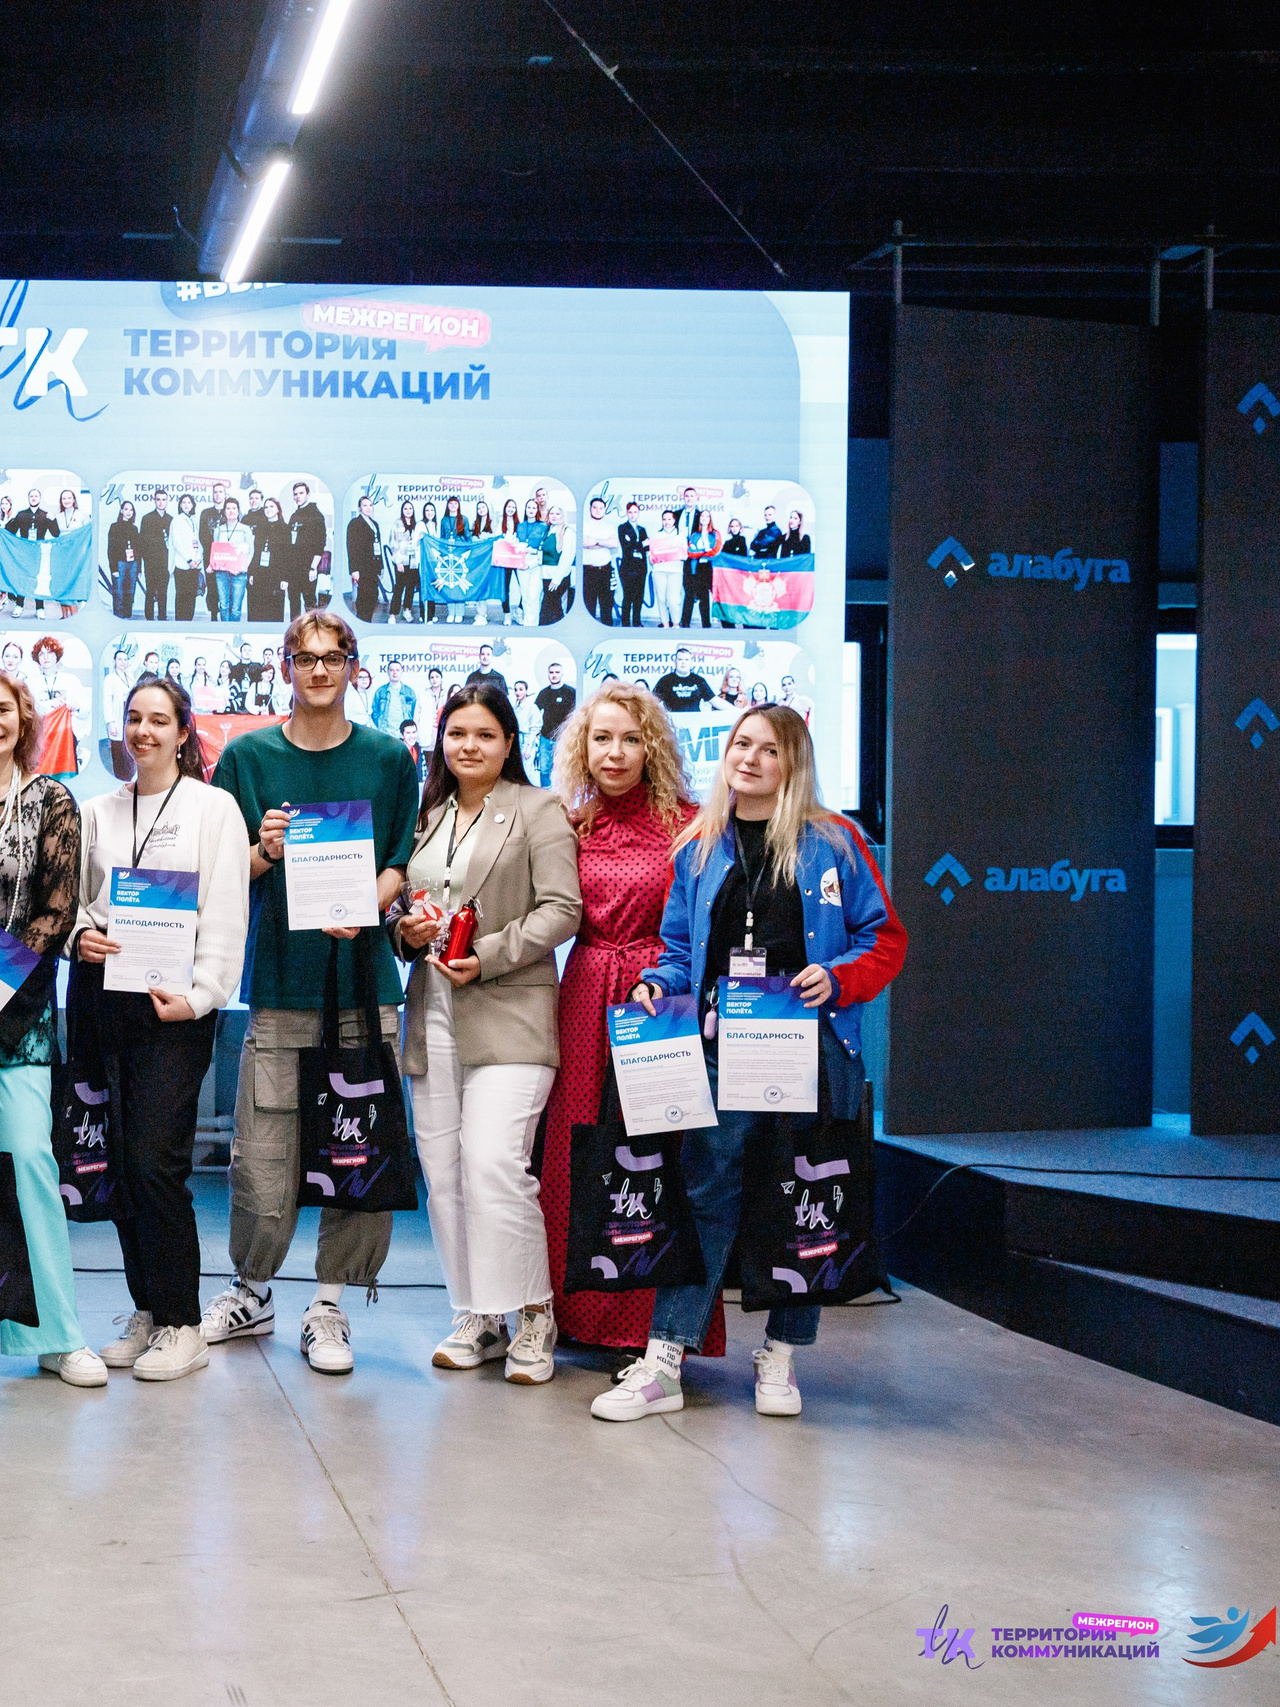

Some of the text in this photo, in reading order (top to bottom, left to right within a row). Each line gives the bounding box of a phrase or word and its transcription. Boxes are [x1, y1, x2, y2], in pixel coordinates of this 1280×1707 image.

[311, 302, 480, 340] МЕЖРЕГИОН
[123, 327, 398, 361] ТЕРРИТОРИЯ
[123, 363, 492, 405] КОММУНИКАЦИЙ
[987, 547, 1131, 592] алабуга
[291, 853, 363, 864] БЛАГОДАРНОСТЬ
[984, 860, 1128, 902] алабуга
[115, 918, 185, 929] БЛАГОДАРНОСТЬ
[615, 1026, 639, 1035] ВЕКТОР
[726, 1032, 805, 1040] БЛАГОДАРНОСТЬ
[620, 1050, 692, 1066] БЛАГОДАРНОСТЬ
